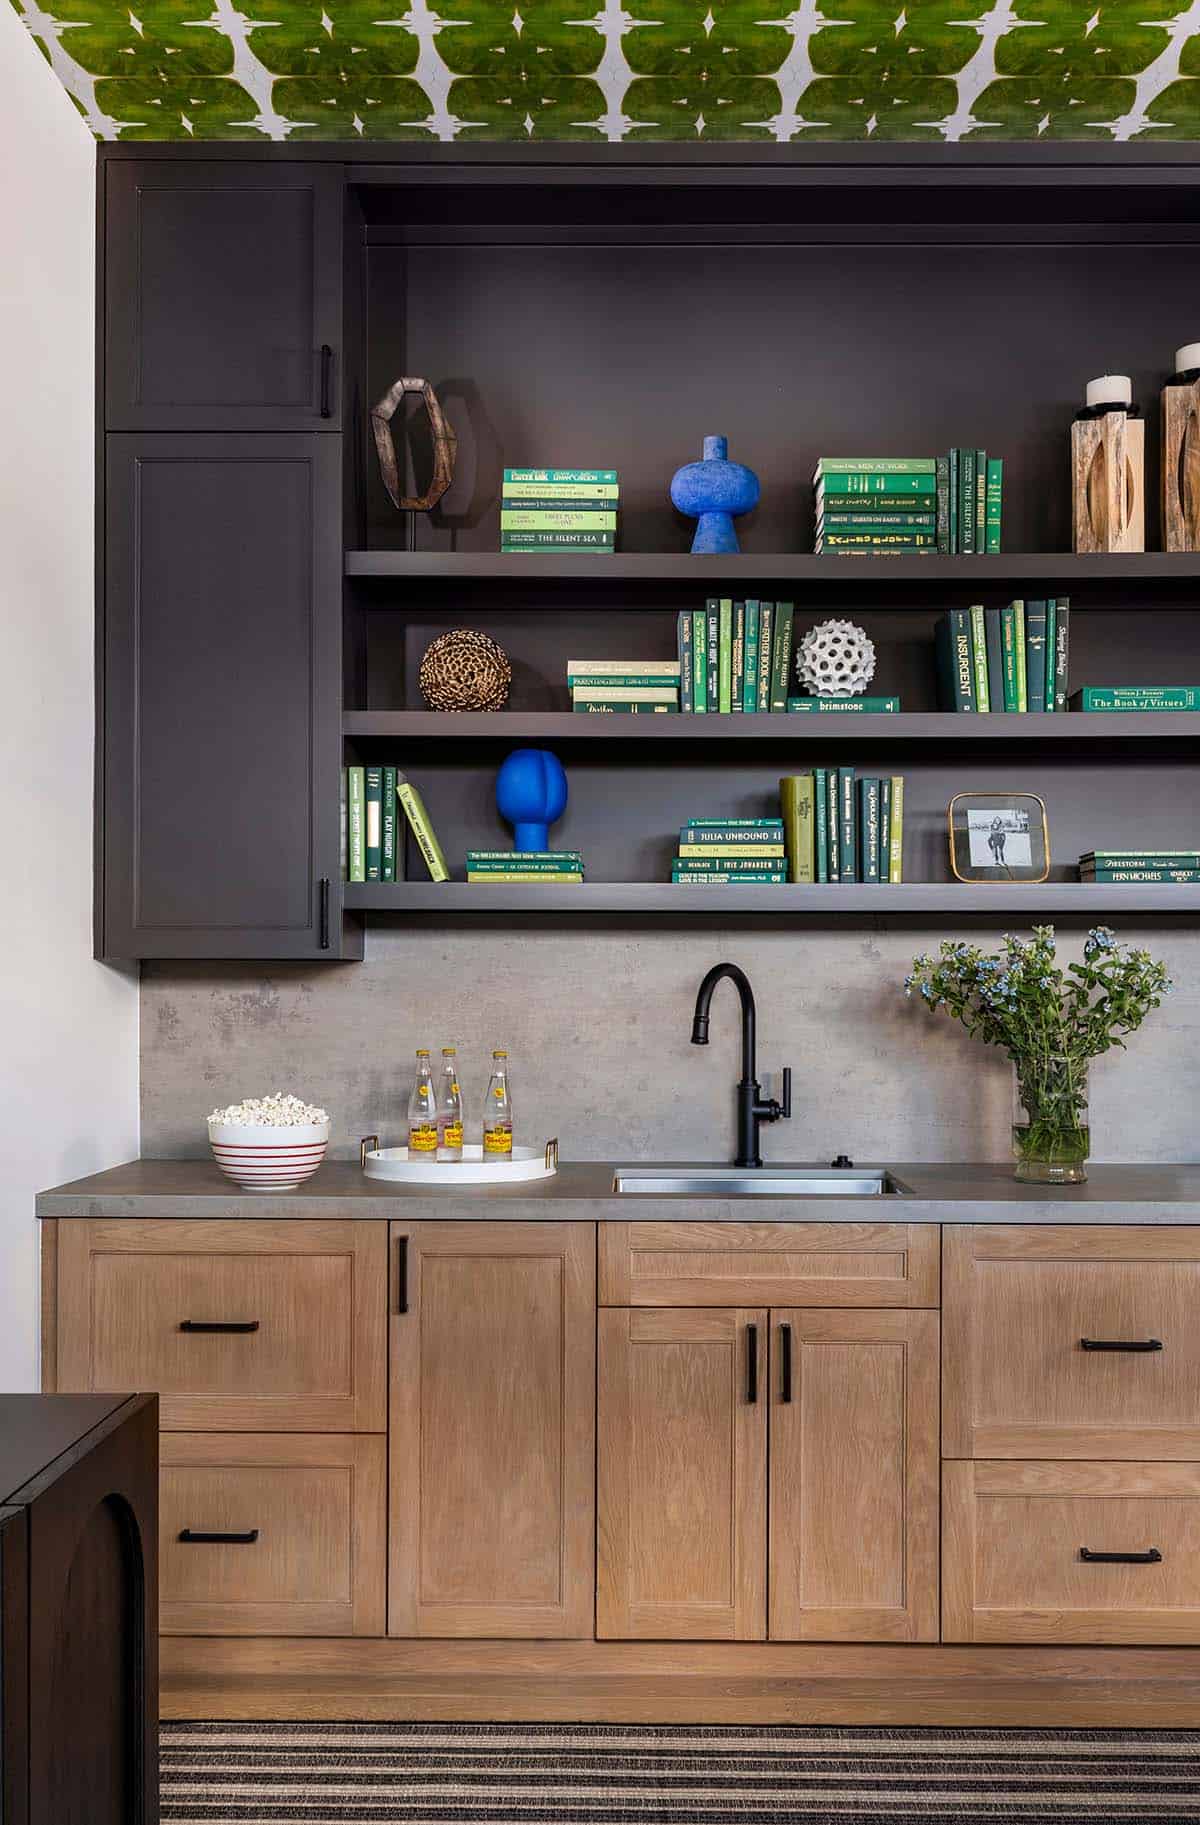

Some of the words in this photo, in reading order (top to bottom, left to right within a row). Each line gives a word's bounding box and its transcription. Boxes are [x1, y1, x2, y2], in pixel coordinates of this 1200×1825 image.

[964, 502, 972, 528] SILENT
[538, 534, 553, 542] THE
[555, 534, 580, 542] SILENT
[583, 534, 598, 543] SEA
[964, 529, 972, 544] SEA
[709, 616, 718, 642] CLIMATE
[1056, 625, 1067, 652] Shaping
[709, 648, 718, 665] HOPE
[760, 656, 769, 678] BOOK
[956, 634, 971, 697] INSURGENT
[819, 701, 864, 711] brimstone
[1092, 699, 1111, 707] The
[1114, 698, 1138, 707] Book
[1140, 699, 1149, 709] of
[1150, 699, 1184, 707] Virtues
[385, 816, 393, 831] PLAY
[701, 832, 723, 841] JULIA
[725, 832, 769, 841] UNBOUND
[385, 832, 393, 860] HUNGRY
[1112, 872, 1129, 880] FERN
[1129, 872, 1162, 881] MICHAELS
